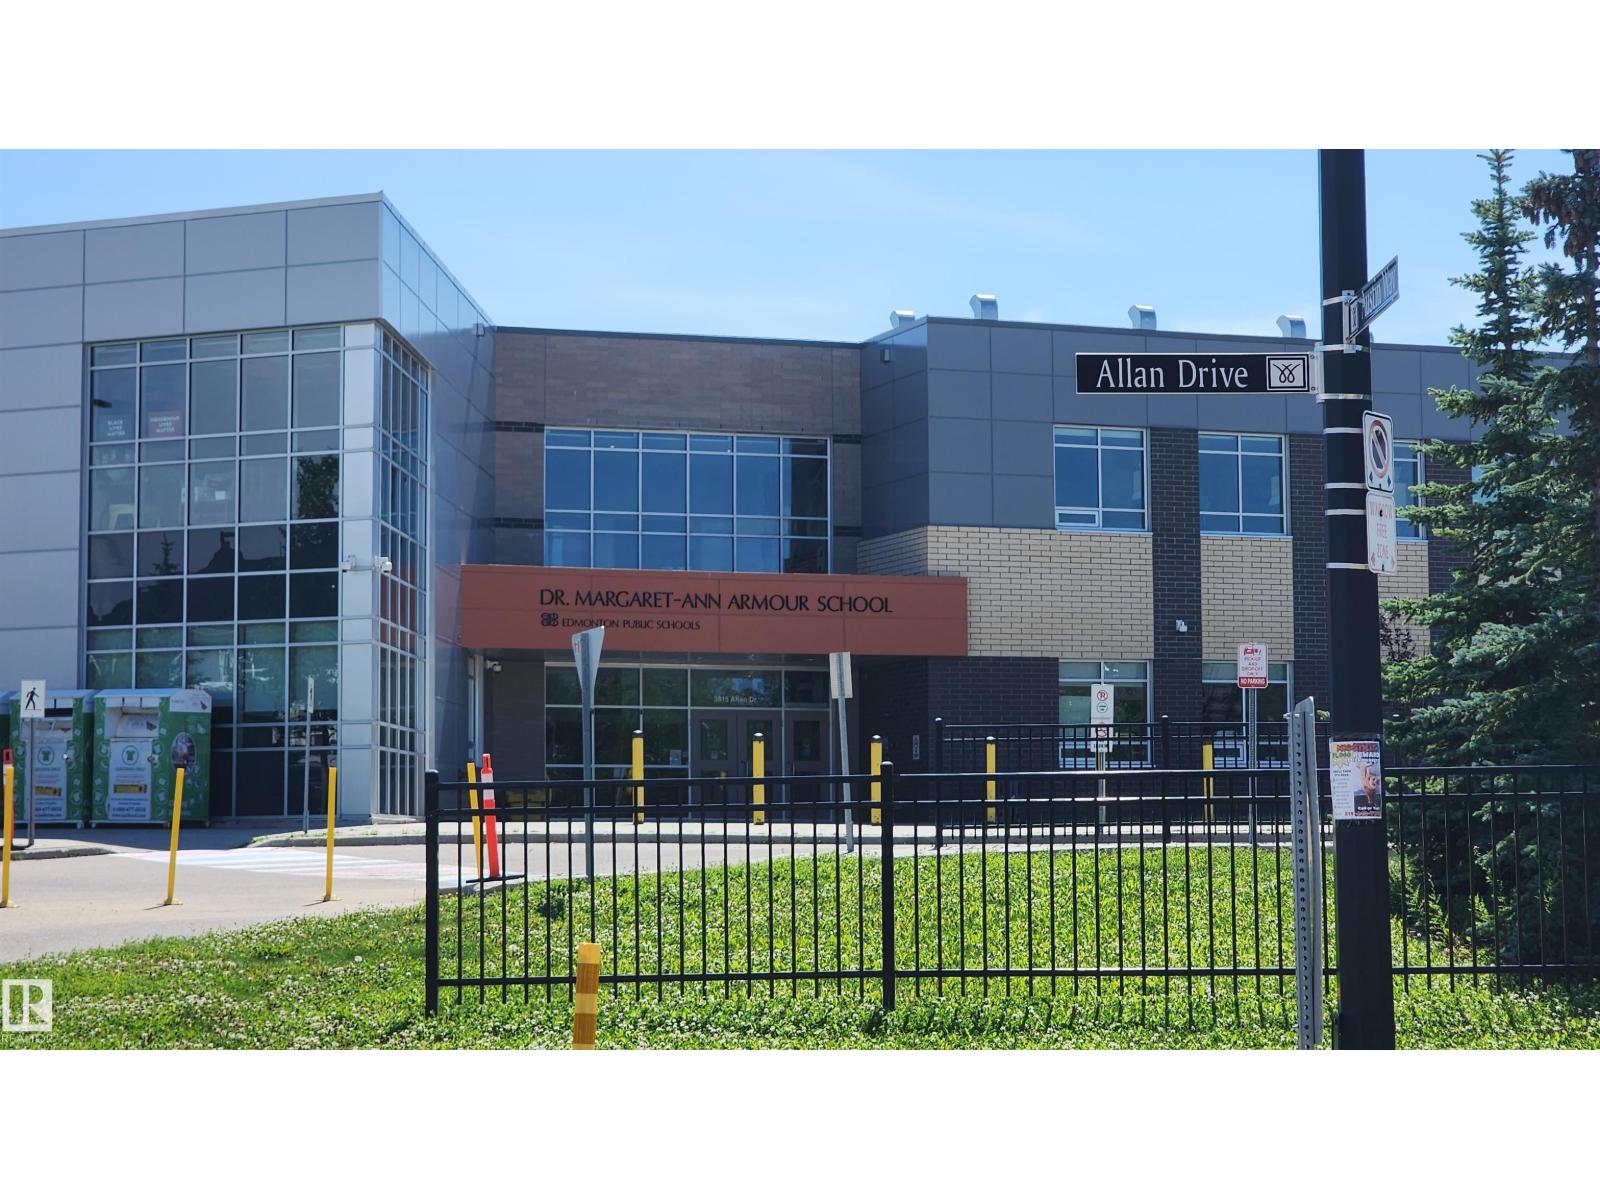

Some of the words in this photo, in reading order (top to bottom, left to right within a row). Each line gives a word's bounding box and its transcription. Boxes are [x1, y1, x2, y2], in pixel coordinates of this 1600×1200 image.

[1096, 357, 1165, 388] Allan
[1178, 357, 1249, 388] Drive
[540, 589, 570, 606] DR.
[574, 590, 721, 609] MARGARET-ANN
[727, 593, 810, 612] ARMOUR
[817, 595, 893, 613] SCHOOL
[562, 617, 619, 628] EDMONTON
[623, 619, 654, 629] PUBLIC
[656, 620, 701, 630] SCHOOLS
